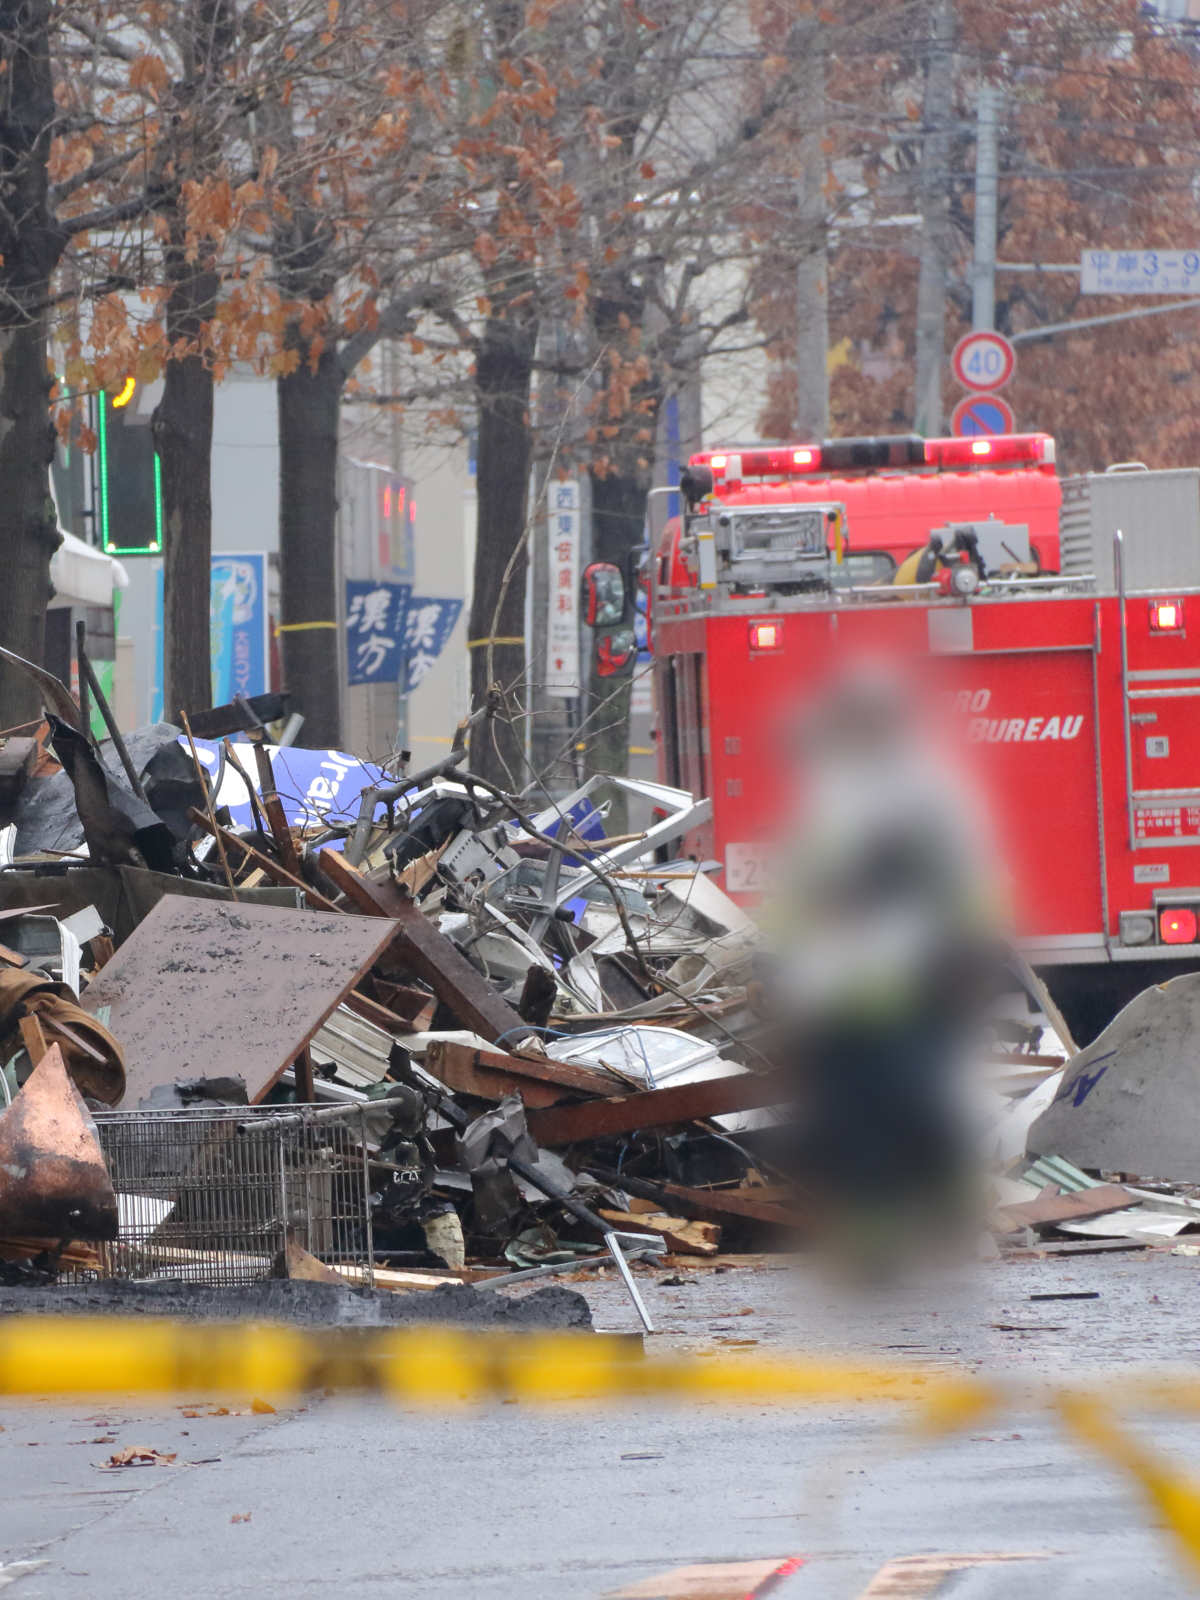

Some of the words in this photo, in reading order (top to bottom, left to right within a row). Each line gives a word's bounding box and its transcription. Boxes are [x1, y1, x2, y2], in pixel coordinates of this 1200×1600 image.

[968, 349, 1000, 375] 40
[345, 588, 396, 675] 漢方
[404, 604, 443, 687] 漢方
[965, 714, 1084, 743] BUREAU
